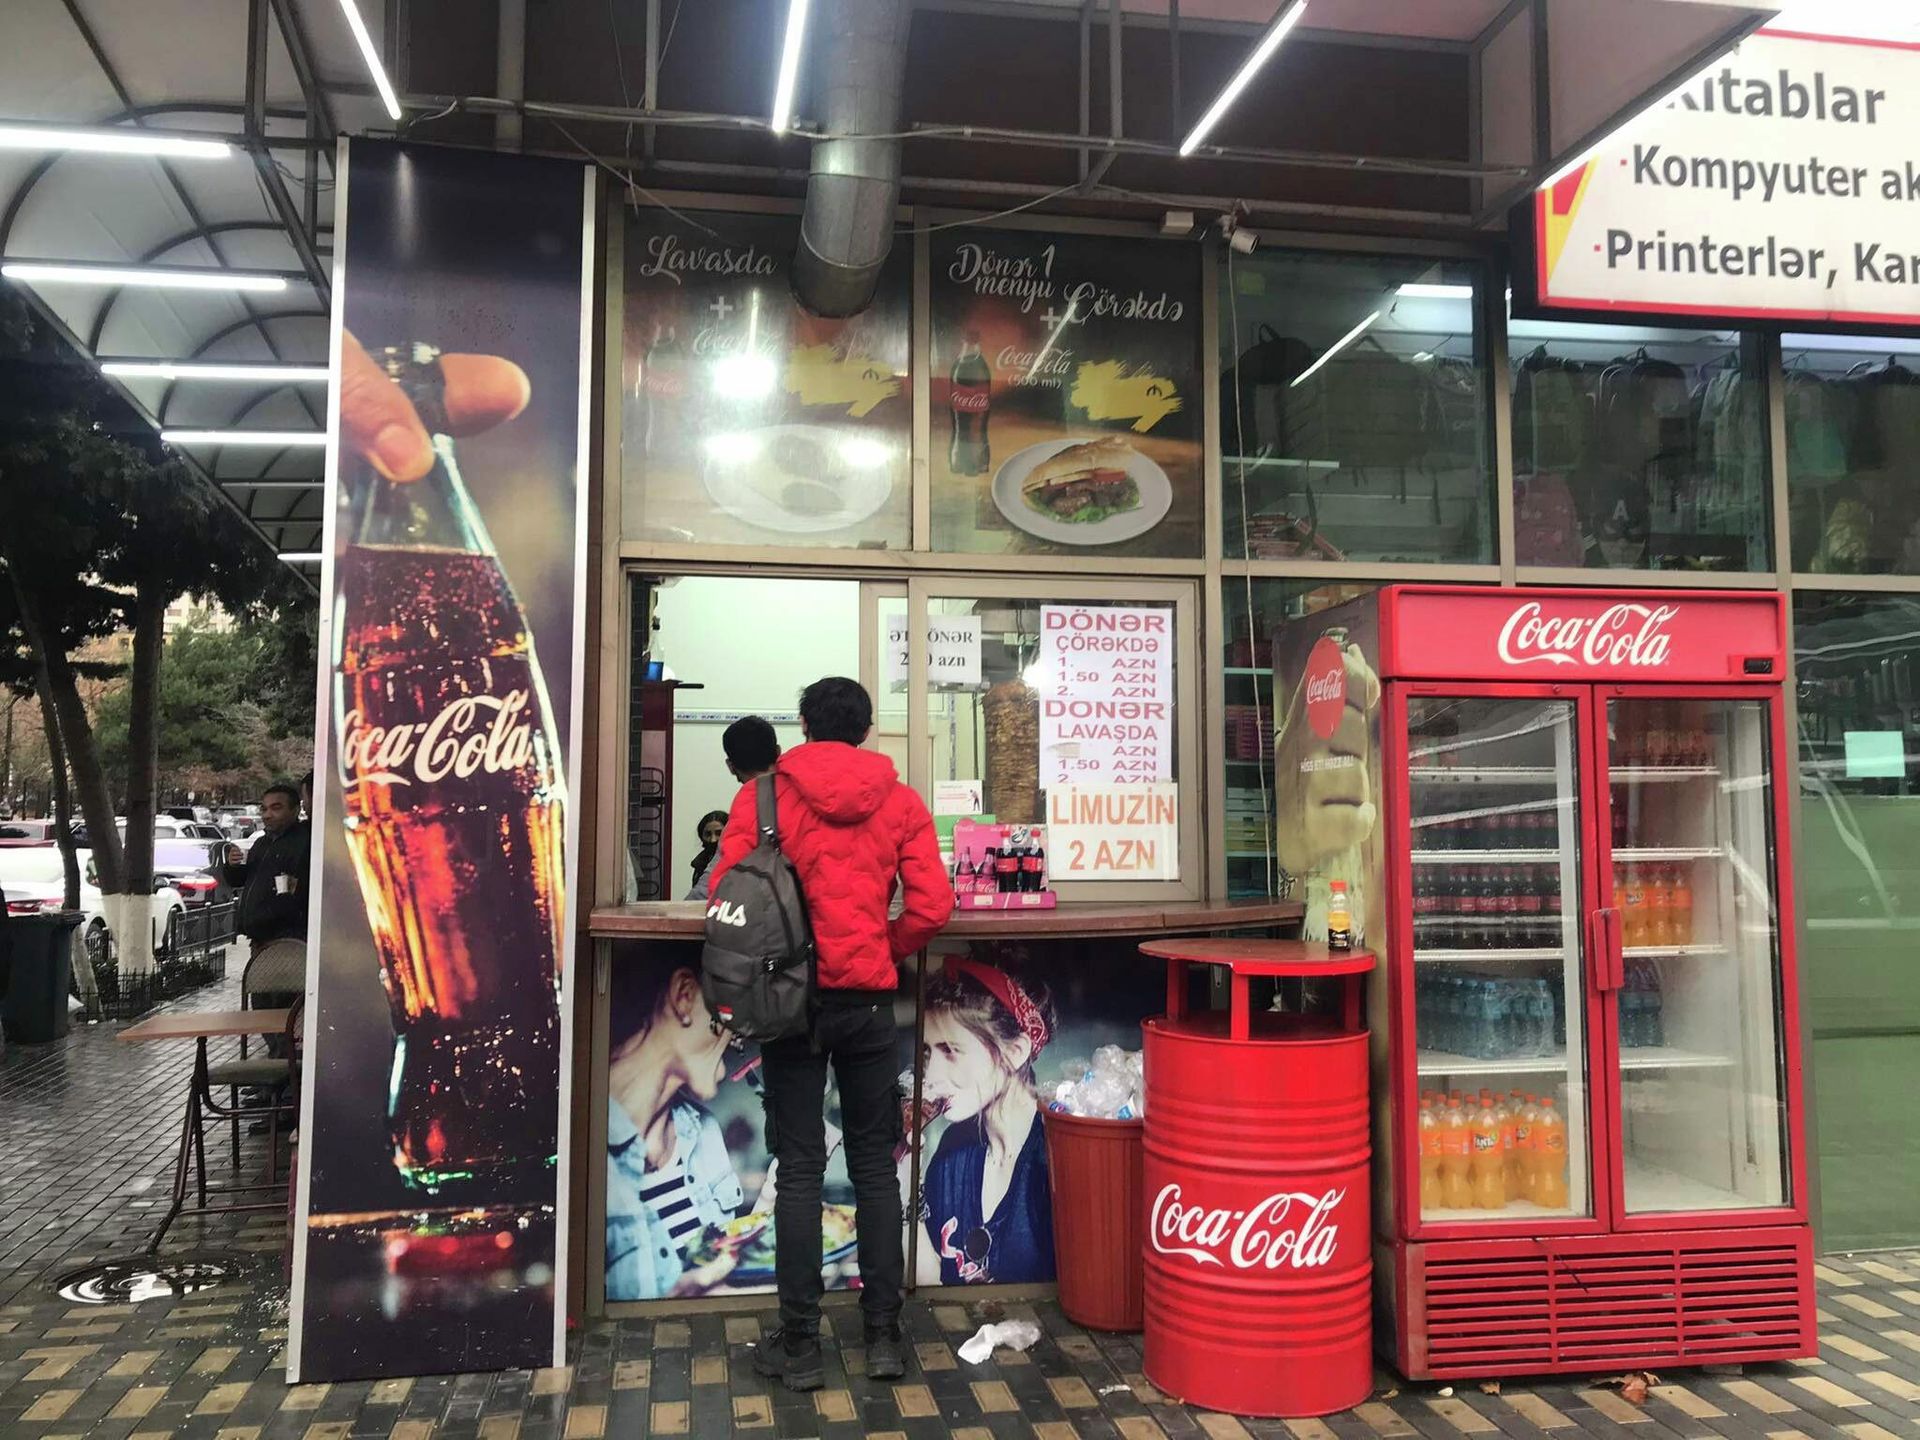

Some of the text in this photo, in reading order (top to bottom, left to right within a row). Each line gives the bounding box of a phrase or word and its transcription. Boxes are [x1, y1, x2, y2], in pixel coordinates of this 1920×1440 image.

[1632, 143, 1868, 202] Kompyuter
[948, 242, 1056, 284] Dönər 1
[1606, 229, 1838, 290] Printerlər,
[974, 274, 1056, 314] menyu
[1045, 608, 1166, 633] DÖNƏR
[927, 627, 973, 643] ÖNƏR
[1056, 632, 1159, 654] ÇÖRƏKDƏ
[1497, 601, 1681, 666] Coca-Cola
[938, 655, 966, 667] azn
[1111, 658, 1157, 669] AZN
[1057, 671, 1157, 684] 1.50 AZN
[1111, 686, 1157, 698] AZN
[337, 688, 534, 788] Coca-Cola
[1057, 723, 1159, 744] LAVAŞDA
[1112, 745, 1157, 757] AZN
[1058, 759, 1157, 772] 1.50 AZN
[1113, 774, 1157, 784] AZN
[1052, 786, 1175, 826] LİMUZİN
[1068, 838, 1156, 871] 2 AZN
[706, 898, 748, 927] FILA
[1150, 1183, 1347, 1270] Coca-Cola
